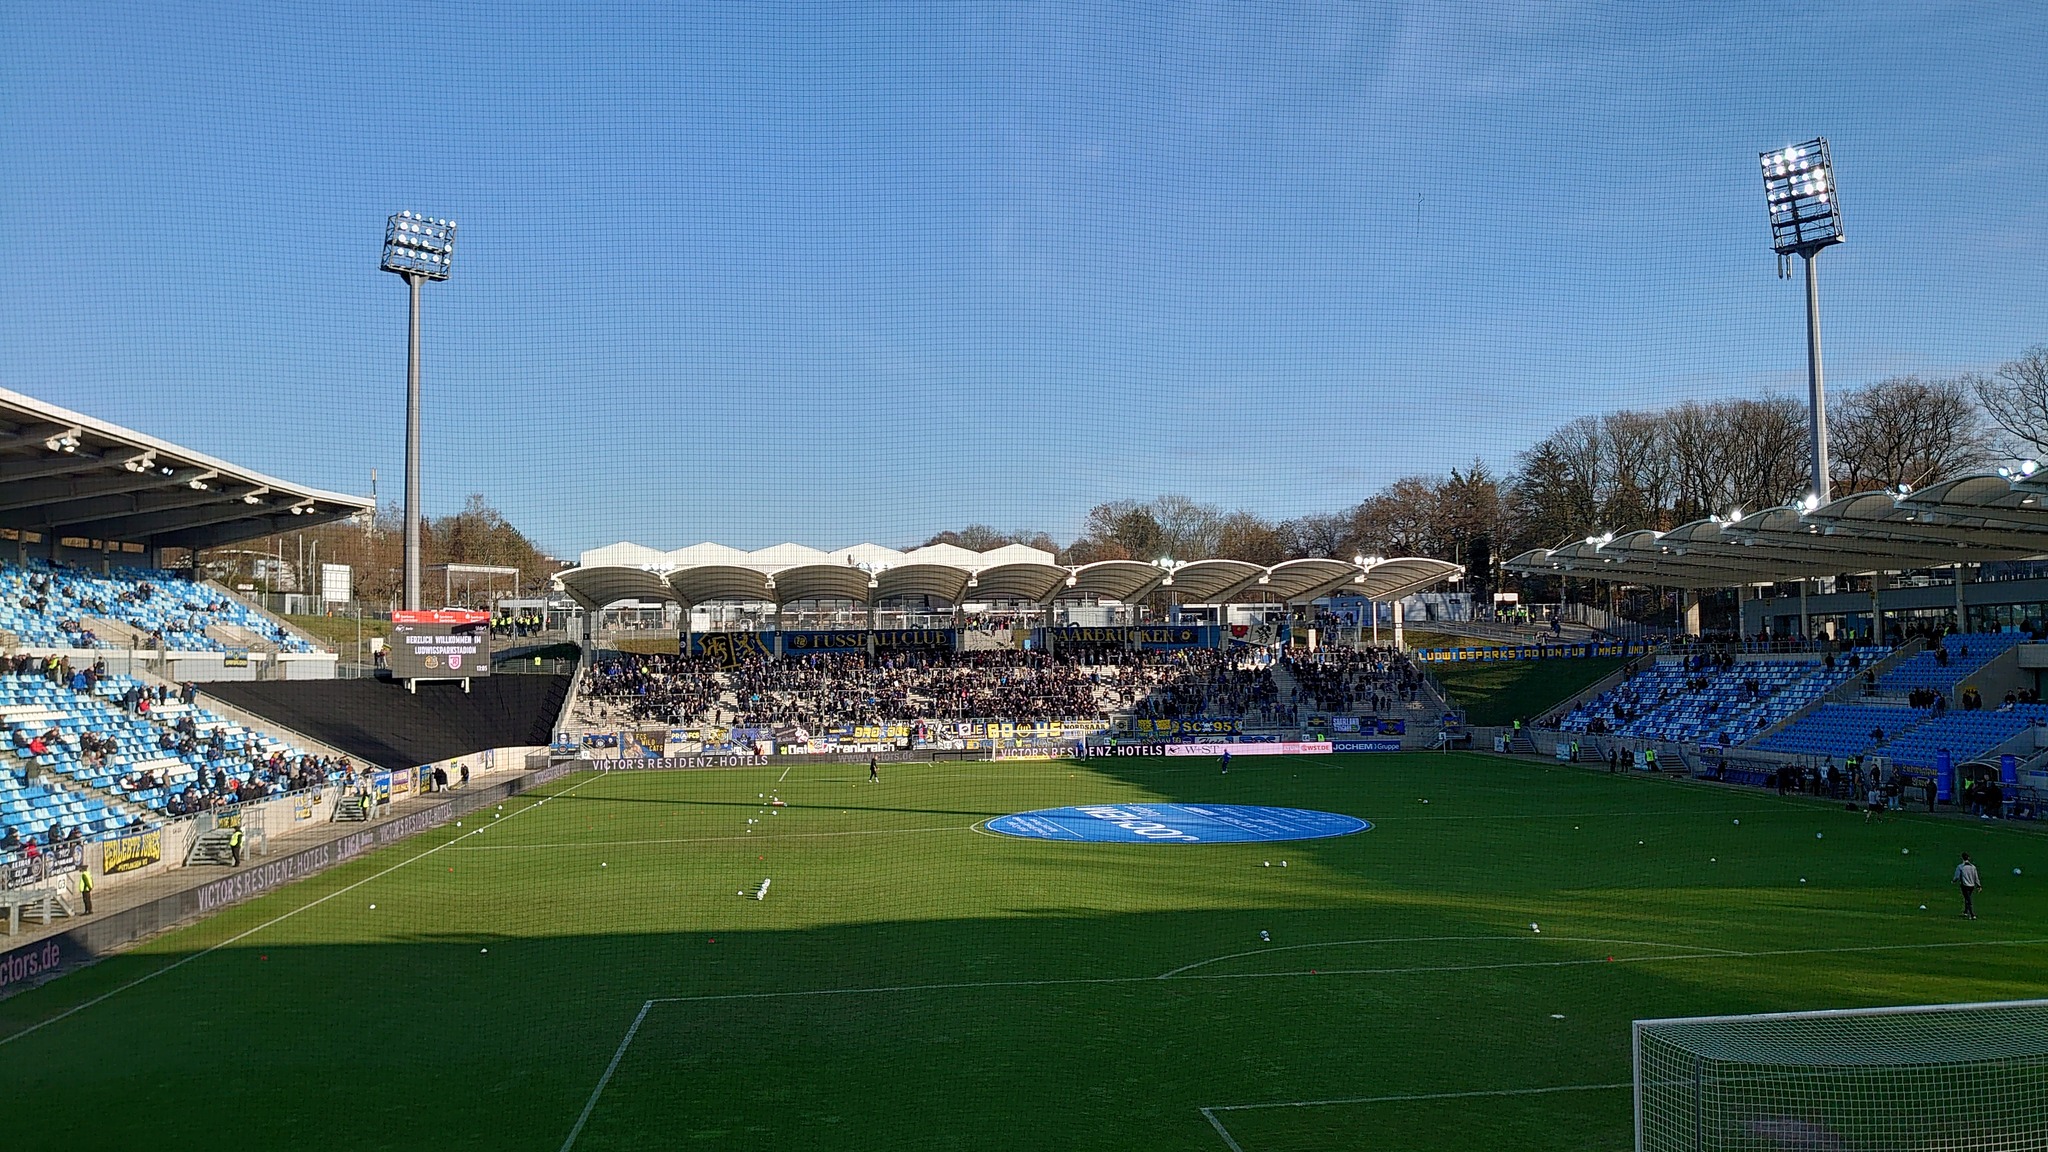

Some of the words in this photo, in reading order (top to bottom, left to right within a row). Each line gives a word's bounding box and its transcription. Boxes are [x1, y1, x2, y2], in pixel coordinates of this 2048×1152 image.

[406, 636, 432, 644] HERZLICH
[435, 636, 471, 644] WILLKOMMEN
[474, 636, 481, 644] IM
[415, 646, 476, 655] LUDWIGSPARKSTADION
[1001, 748, 1048, 758] VICTOR'S
[593, 759, 644, 770] VICTOR'S
[648, 756, 768, 769] RESIDENZ-HOTELS
[198, 875, 242, 911] VICTOR'S
[245, 846, 329, 893] RESIDENZ-HOTELS
